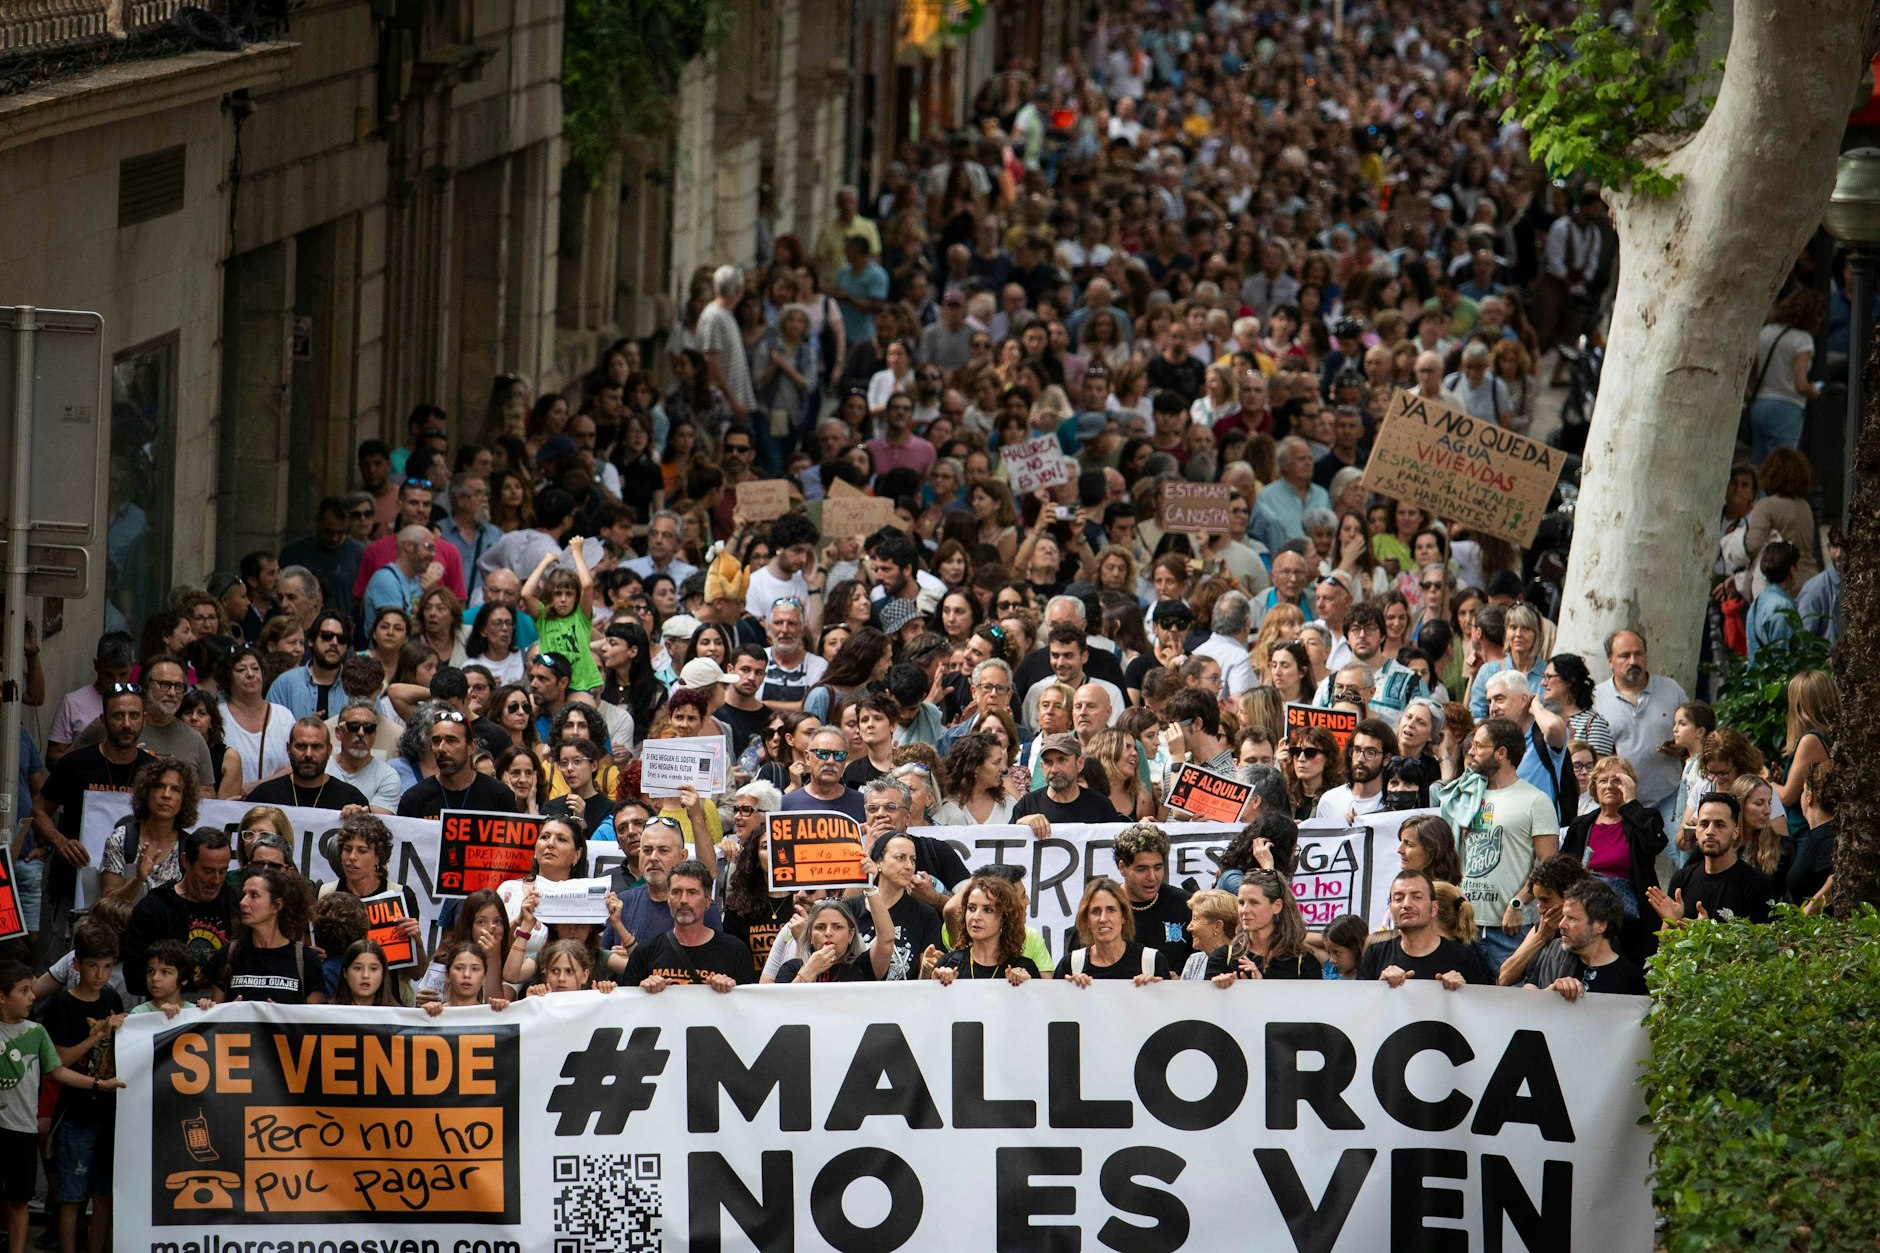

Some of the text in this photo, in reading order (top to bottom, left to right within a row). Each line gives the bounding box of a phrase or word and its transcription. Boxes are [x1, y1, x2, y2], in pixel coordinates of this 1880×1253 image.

[1400, 395, 1551, 471] YA NO QUEDA
[1436, 435, 1492, 464] AGUA
[1377, 449, 1457, 485] ESPACIOS
[1164, 482, 1228, 500] ESTIMAM
[1386, 479, 1407, 495] SUS
[1397, 471, 1499, 514] PARA MALLORCA
[1288, 708, 1356, 731] SE VENDE
[1181, 768, 1247, 802] SE ALQUILA
[445, 817, 543, 846] SE VEND
[772, 817, 860, 841] SE ALQUILA
[817, 849, 832, 859] NO
[809, 866, 851, 877] PAGAR
[1315, 876, 1342, 899] ho
[268, 977, 299, 989] GUAJES
[170, 1032, 497, 1096] SE VENDE
[546, 1019, 1576, 1143] #MALLORCA
[248, 1110, 494, 1154] Però no ho
[255, 1163, 480, 1213] puc pagar
[687, 1145, 1574, 1253] NO ES VEN
